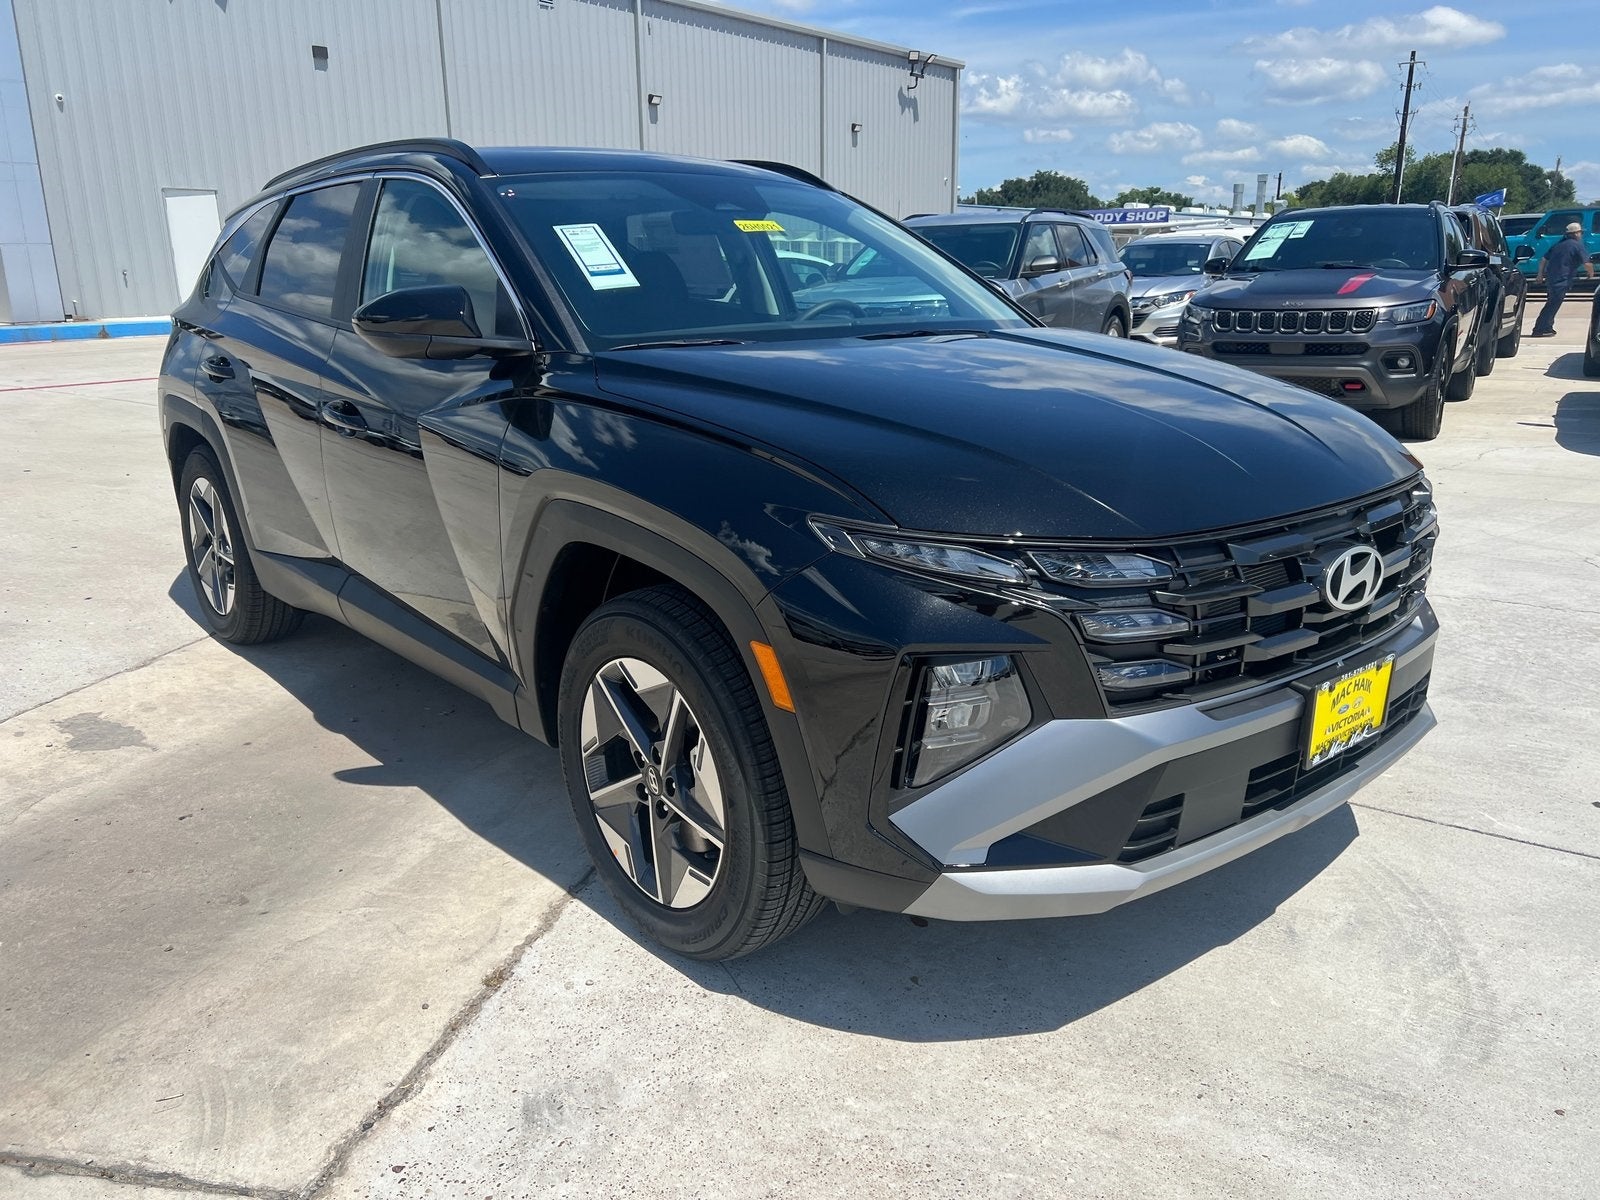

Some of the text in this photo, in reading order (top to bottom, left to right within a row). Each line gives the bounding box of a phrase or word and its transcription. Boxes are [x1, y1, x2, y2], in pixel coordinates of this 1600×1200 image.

[1090, 211, 1167, 222] ODY SHOP
[1331, 682, 1352, 712] MAC
[1353, 677, 1372, 694] HAIK
[1331, 709, 1366, 733] VICTORIA
